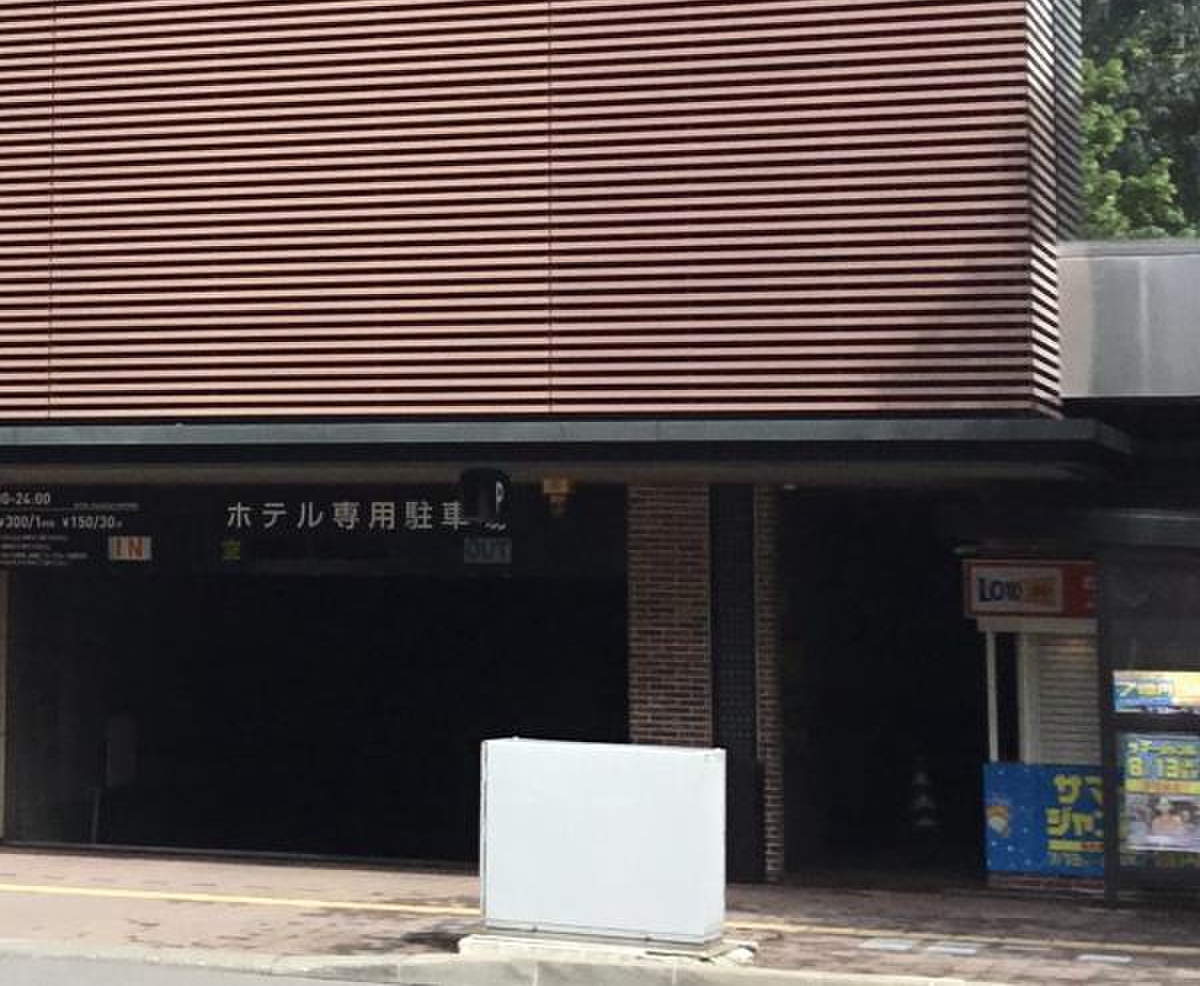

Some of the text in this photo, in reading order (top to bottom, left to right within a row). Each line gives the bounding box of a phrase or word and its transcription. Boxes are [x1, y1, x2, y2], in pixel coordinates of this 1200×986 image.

[227, 501, 506, 531] ホテル専用駐車
[115, 536, 145, 559] IN
